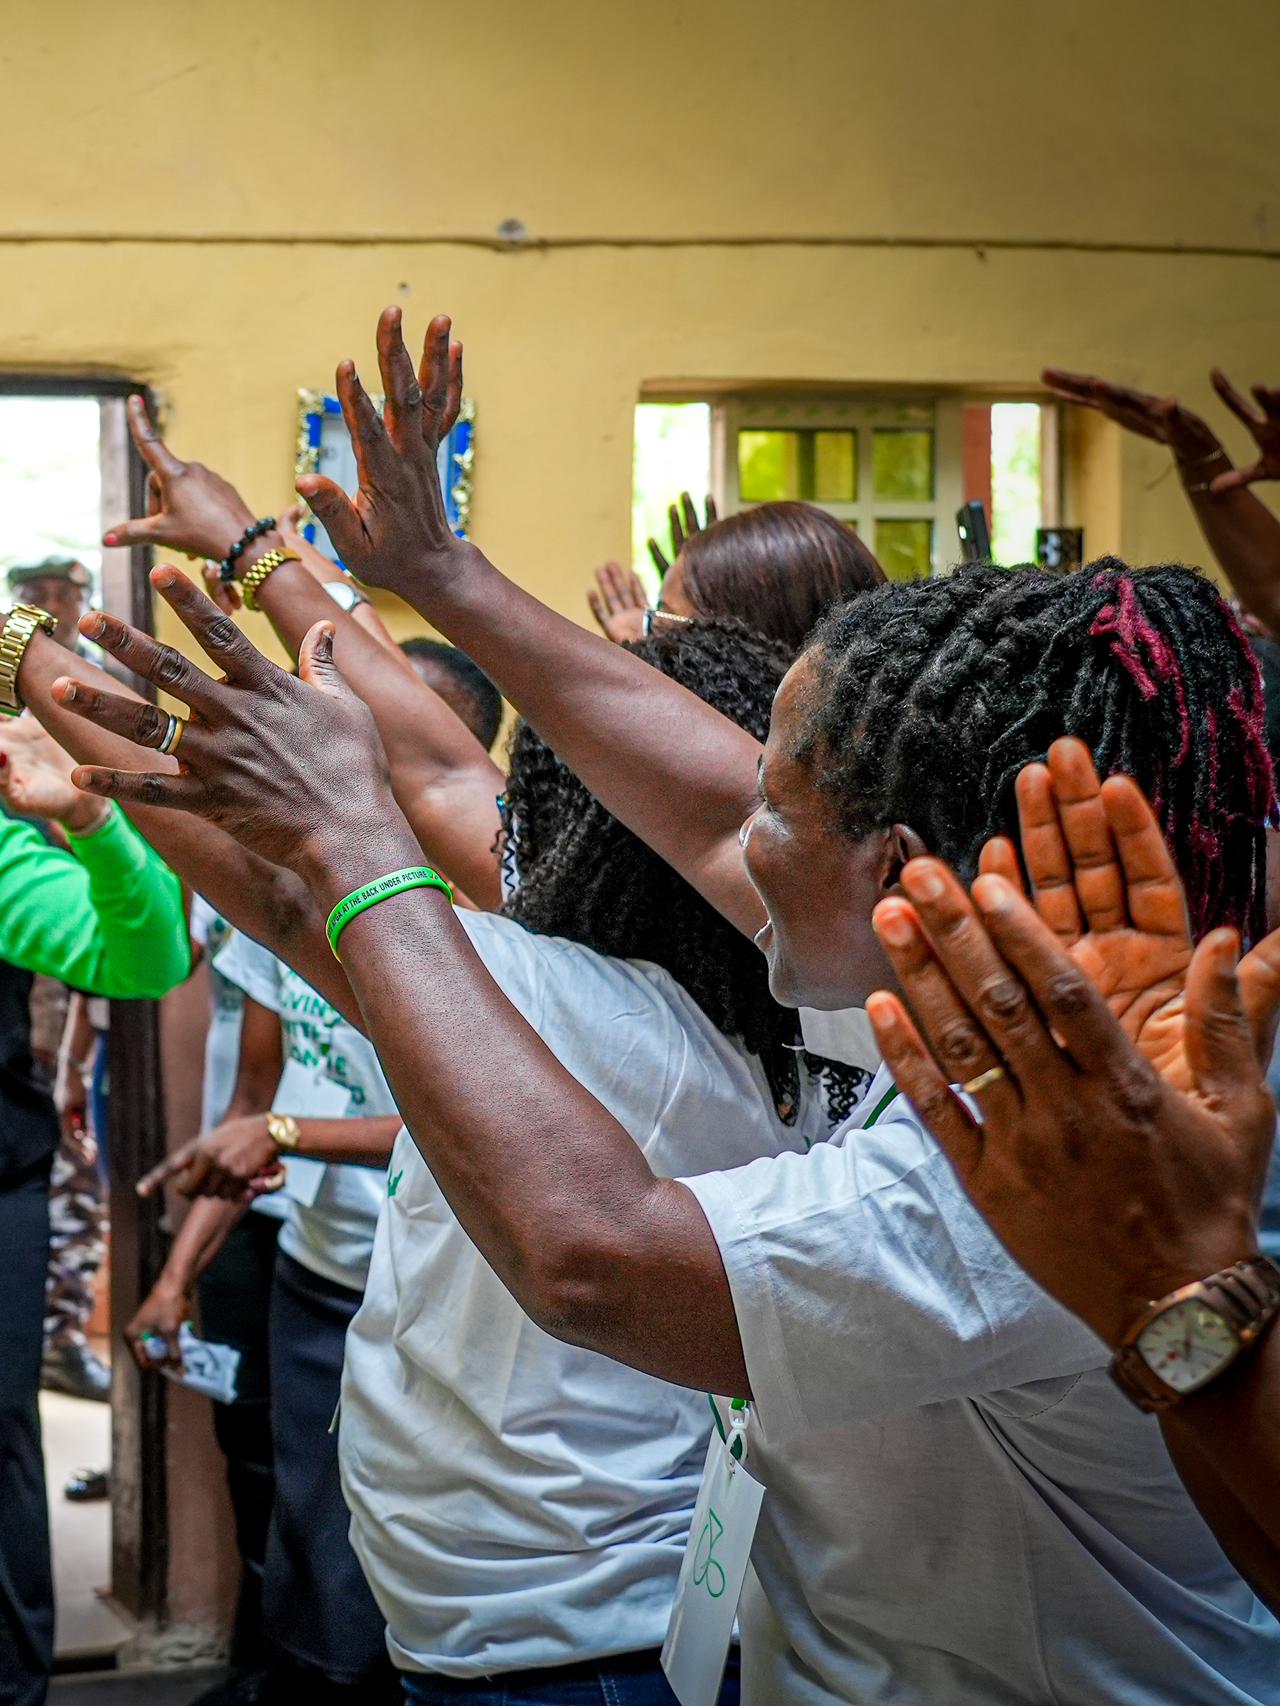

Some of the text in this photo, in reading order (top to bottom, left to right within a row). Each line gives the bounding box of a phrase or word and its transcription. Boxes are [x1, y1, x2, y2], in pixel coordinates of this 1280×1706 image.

[342, 903, 350, 913] AT
[349, 895, 362, 906] THE
[362, 886, 379, 900] BACK
[380, 876, 401, 891] UNDER
[402, 871, 428, 882] PICTURE
